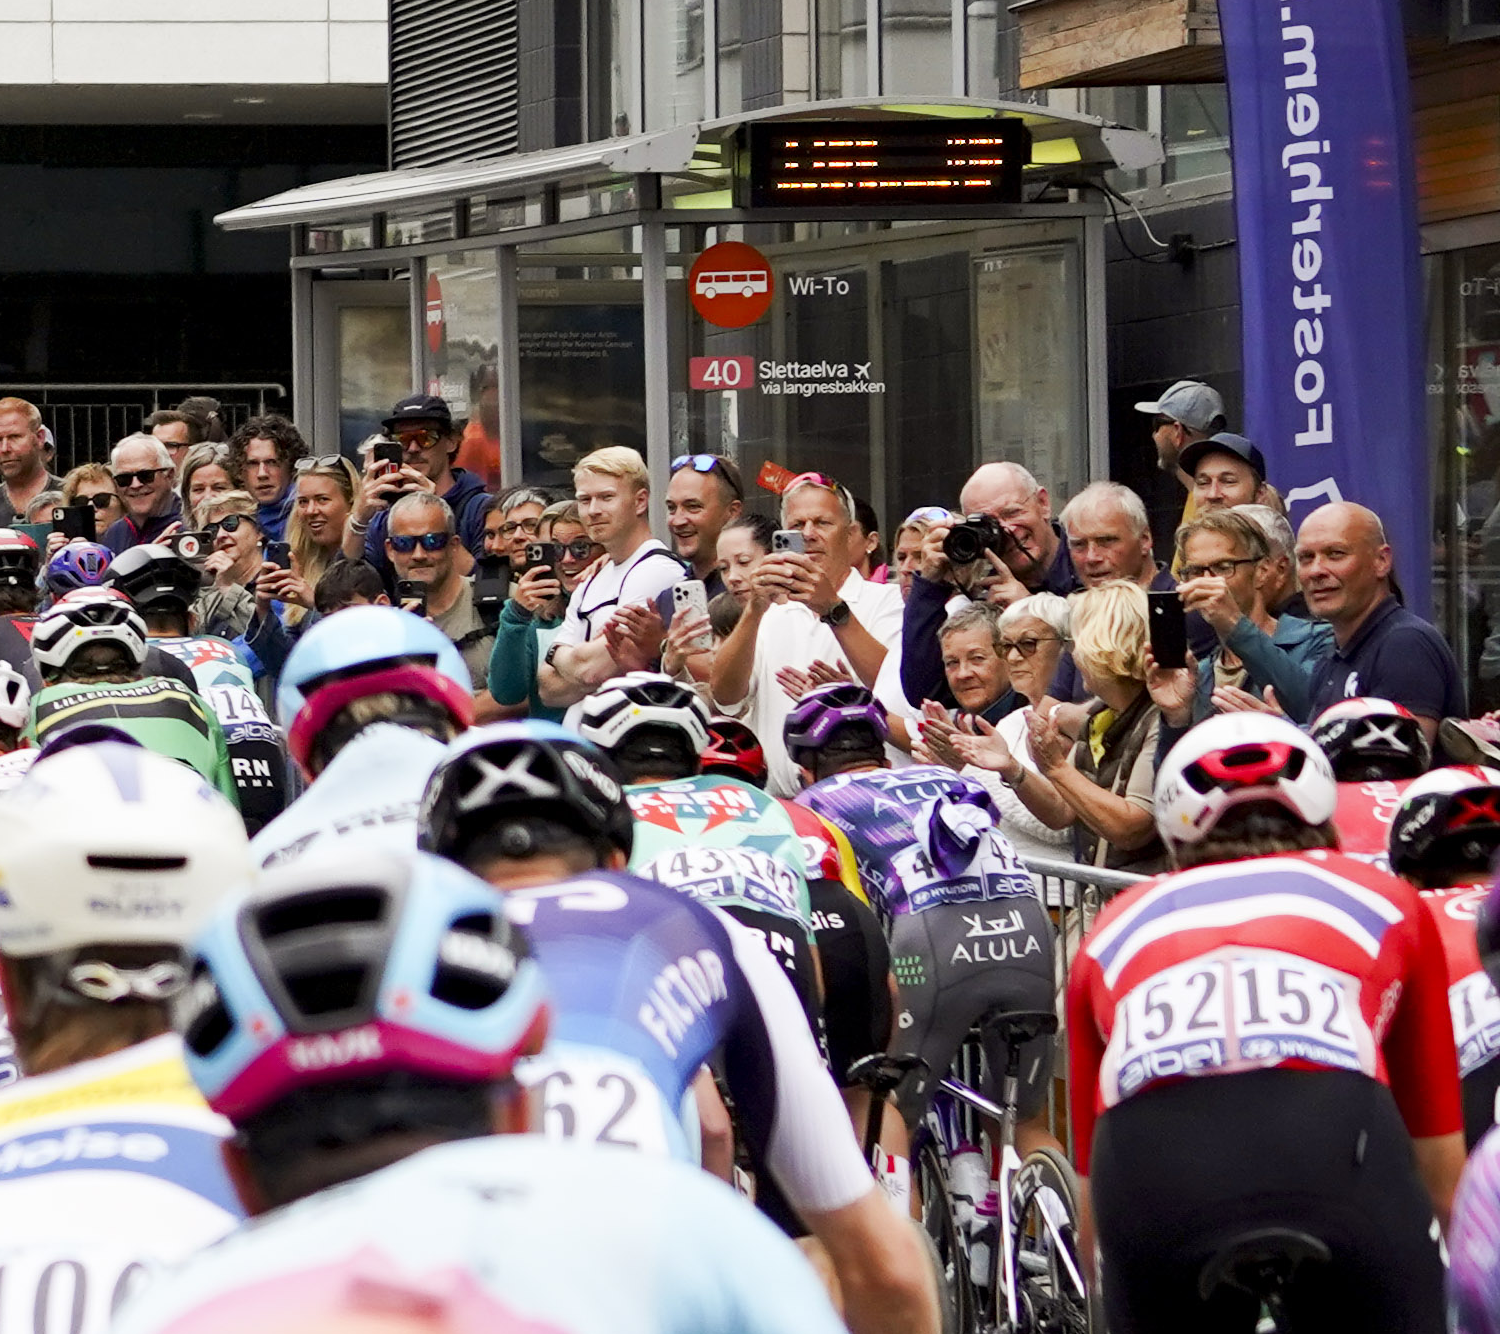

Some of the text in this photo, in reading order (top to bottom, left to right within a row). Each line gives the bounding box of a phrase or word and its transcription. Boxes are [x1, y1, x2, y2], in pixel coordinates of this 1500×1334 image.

[789, 277, 849, 296] Wi-To
[702, 359, 848, 387] 40 Slettaelva
[761, 380, 886, 398] via langnesbakken
[53, 682, 165, 711] LILLEHAMMER
[628, 789, 755, 809] KERN
[929, 880, 981, 898] HYUNDAI
[950, 934, 1042, 964] ALULA
[639, 948, 728, 1059] FACTOR
[1121, 973, 1219, 1050] 152
[1240, 967, 1350, 1041] 152
[541, 1069, 643, 1152] 62
